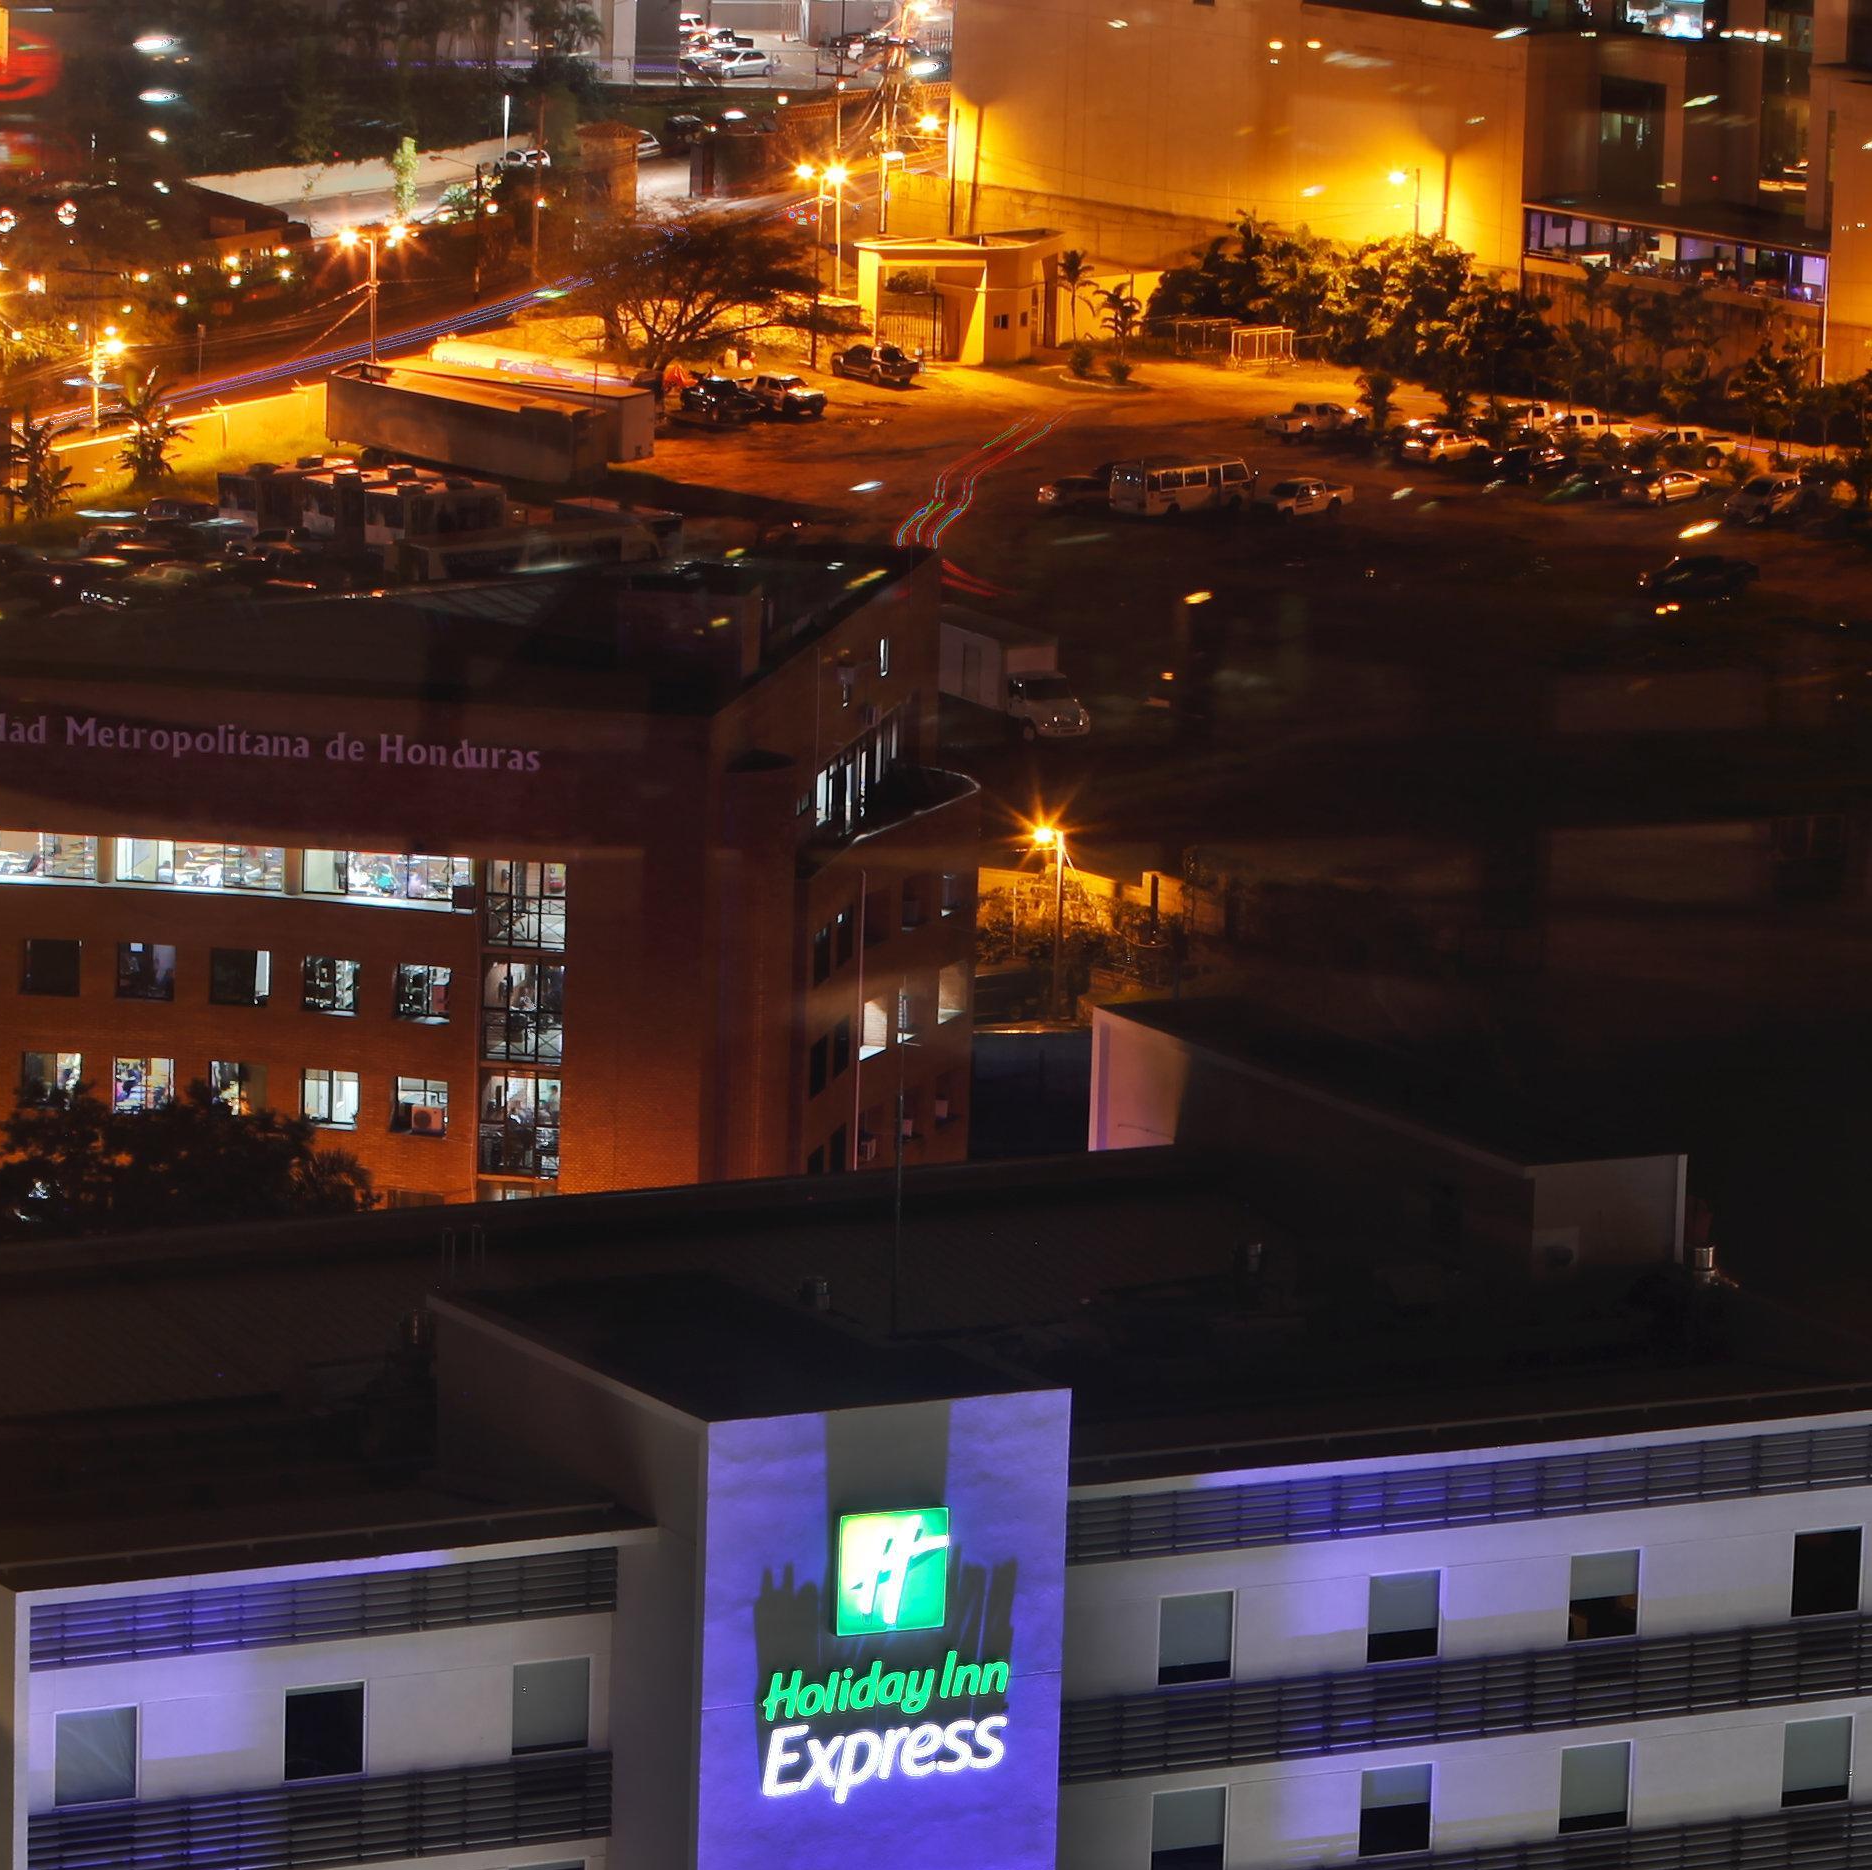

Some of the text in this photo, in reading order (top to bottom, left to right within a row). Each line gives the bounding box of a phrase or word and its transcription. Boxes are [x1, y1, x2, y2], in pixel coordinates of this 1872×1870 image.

[65, 715, 310, 758] Metropolitana
[325, 731, 366, 763] de
[379, 733, 541, 772] Honduras
[762, 1649, 1010, 1722] Holiday Inn
[762, 1715, 1009, 1804] Express
